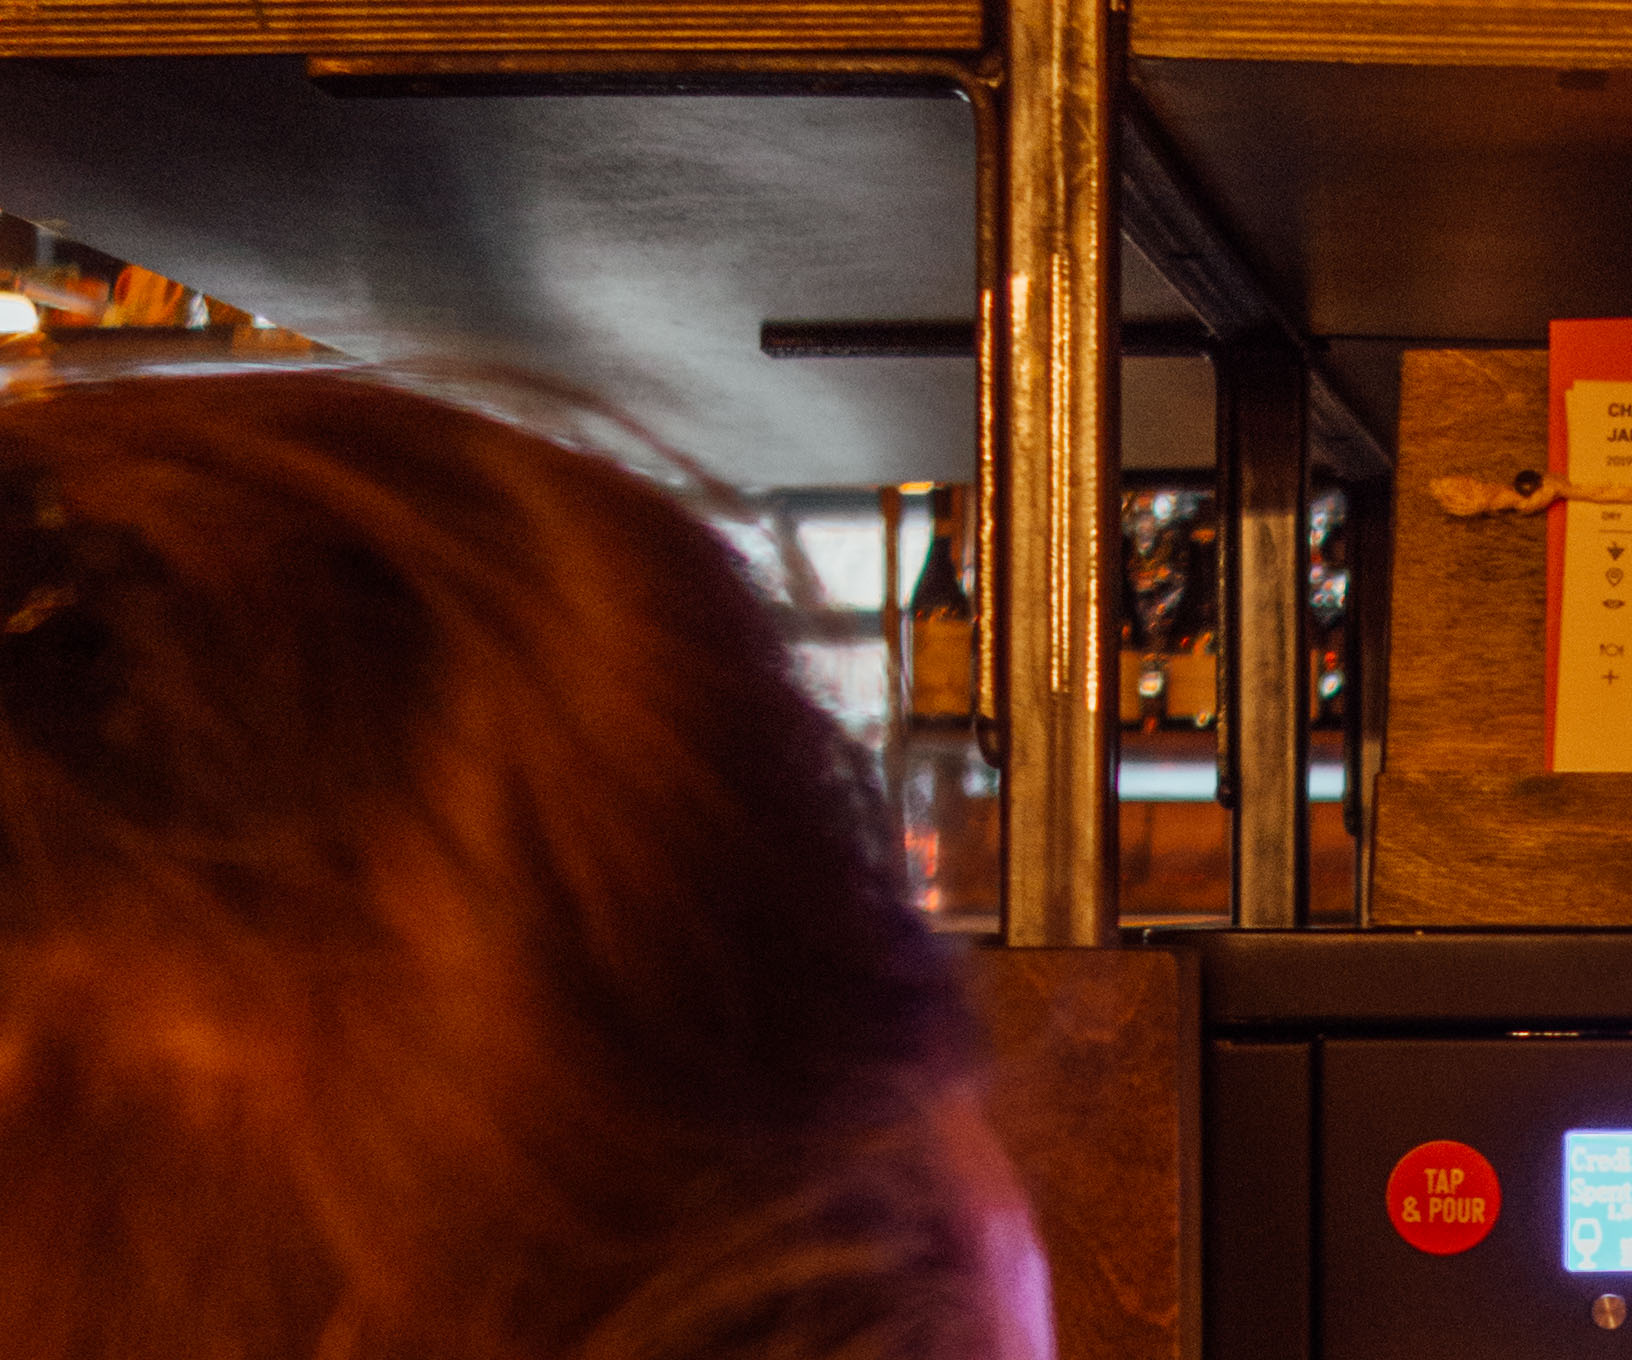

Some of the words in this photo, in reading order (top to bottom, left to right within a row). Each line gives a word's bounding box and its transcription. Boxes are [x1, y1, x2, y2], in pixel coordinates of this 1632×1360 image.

[1601, 512, 1622, 521] DRY
[1424, 1168, 1464, 1194] TAP
[1572, 1178, 1632, 1206] Spent
[1401, 1196, 1421, 1223] &
[1429, 1197, 1486, 1224] POUR
